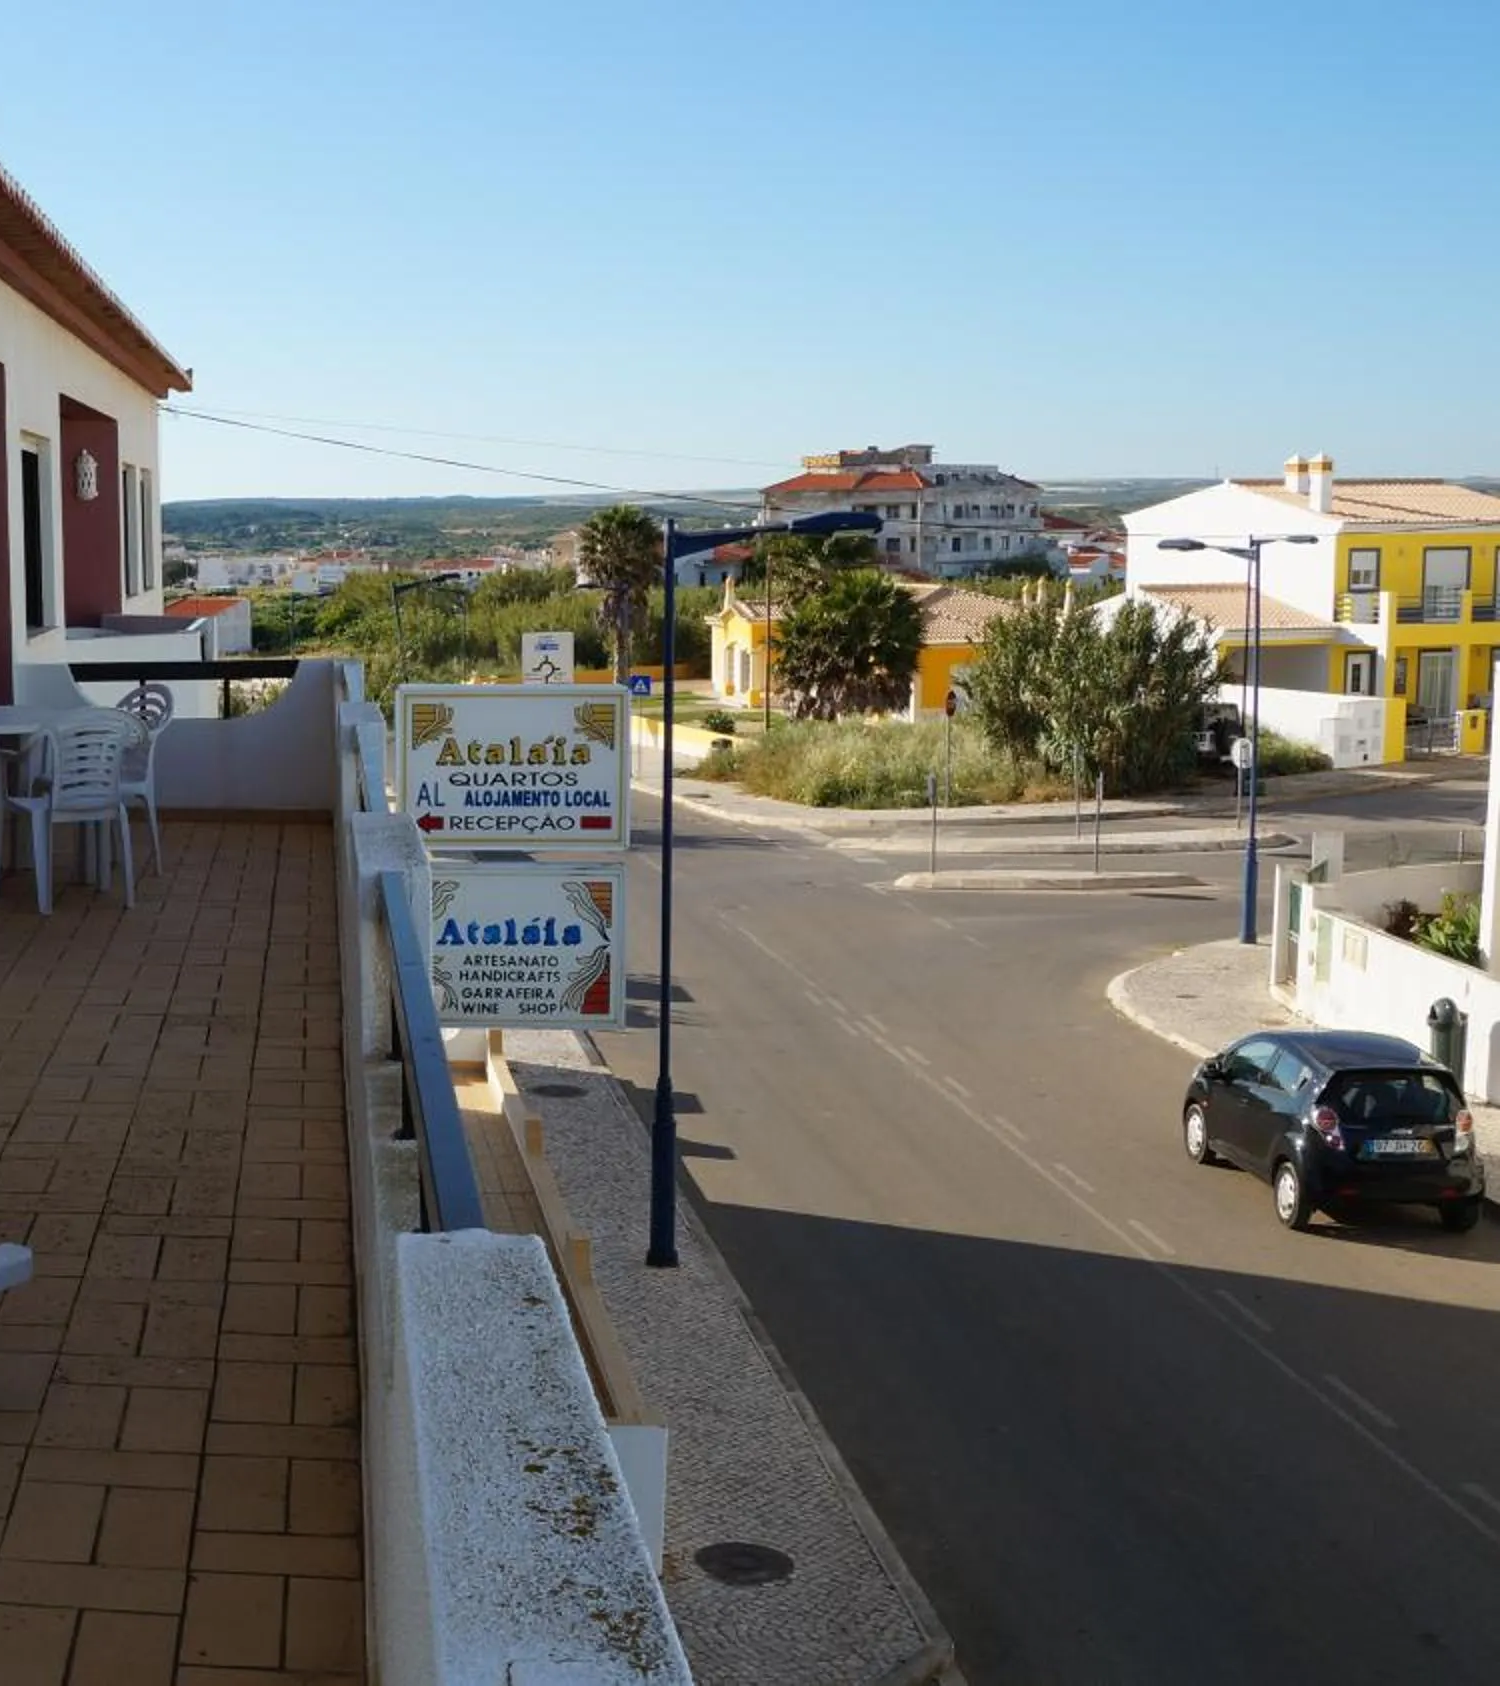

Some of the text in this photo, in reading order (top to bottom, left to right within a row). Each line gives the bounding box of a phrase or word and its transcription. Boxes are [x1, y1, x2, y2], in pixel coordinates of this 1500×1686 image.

[449, 772, 579, 787] QUARTOS
[416, 782, 611, 807] AL ALOJAMENTO LOCAL
[463, 956, 559, 967] ARTESANATO
[459, 971, 561, 983] HANDICRAFTS
[461, 987, 555, 1000] GARRAFEIRA
[461, 1003, 556, 1015] WINE SHOP
